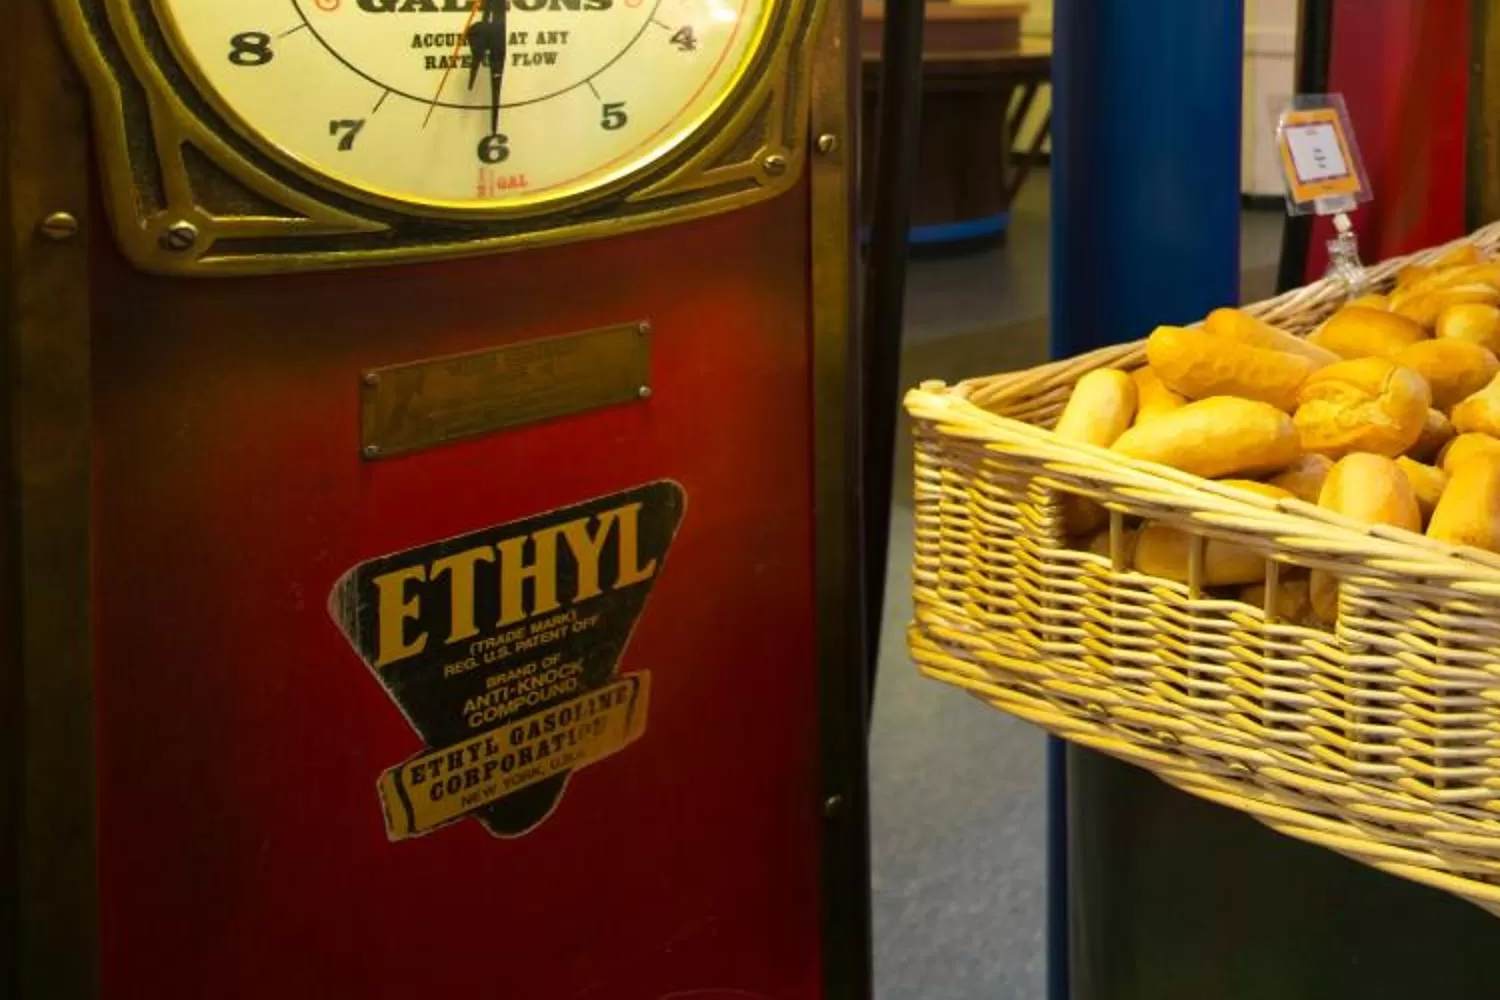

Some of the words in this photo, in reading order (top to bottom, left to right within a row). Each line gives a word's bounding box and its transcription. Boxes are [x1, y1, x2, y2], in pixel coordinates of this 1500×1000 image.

[228, 31, 274, 66] 8
[509, 31, 528, 45] AT
[536, 30, 570, 45] ANY
[668, 24, 697, 51] 4
[424, 56, 472, 70] RATE
[511, 52, 559, 67] FLOW
[601, 102, 628, 131] 5
[329, 119, 365, 151] 7
[477, 134, 510, 164] 6
[372, 502, 658, 667] ETHYL
[469, 627, 526, 656] (TRADE
[515, 625, 570, 651] PATENT
[464, 657, 584, 714] ANTI-KNOCK
[486, 662, 537, 689] BRAND
[541, 652, 562, 669] OF
[468, 678, 578, 728] COMPOUND
[411, 732, 500, 785] ETHYL
[461, 783, 498, 808] NEW
